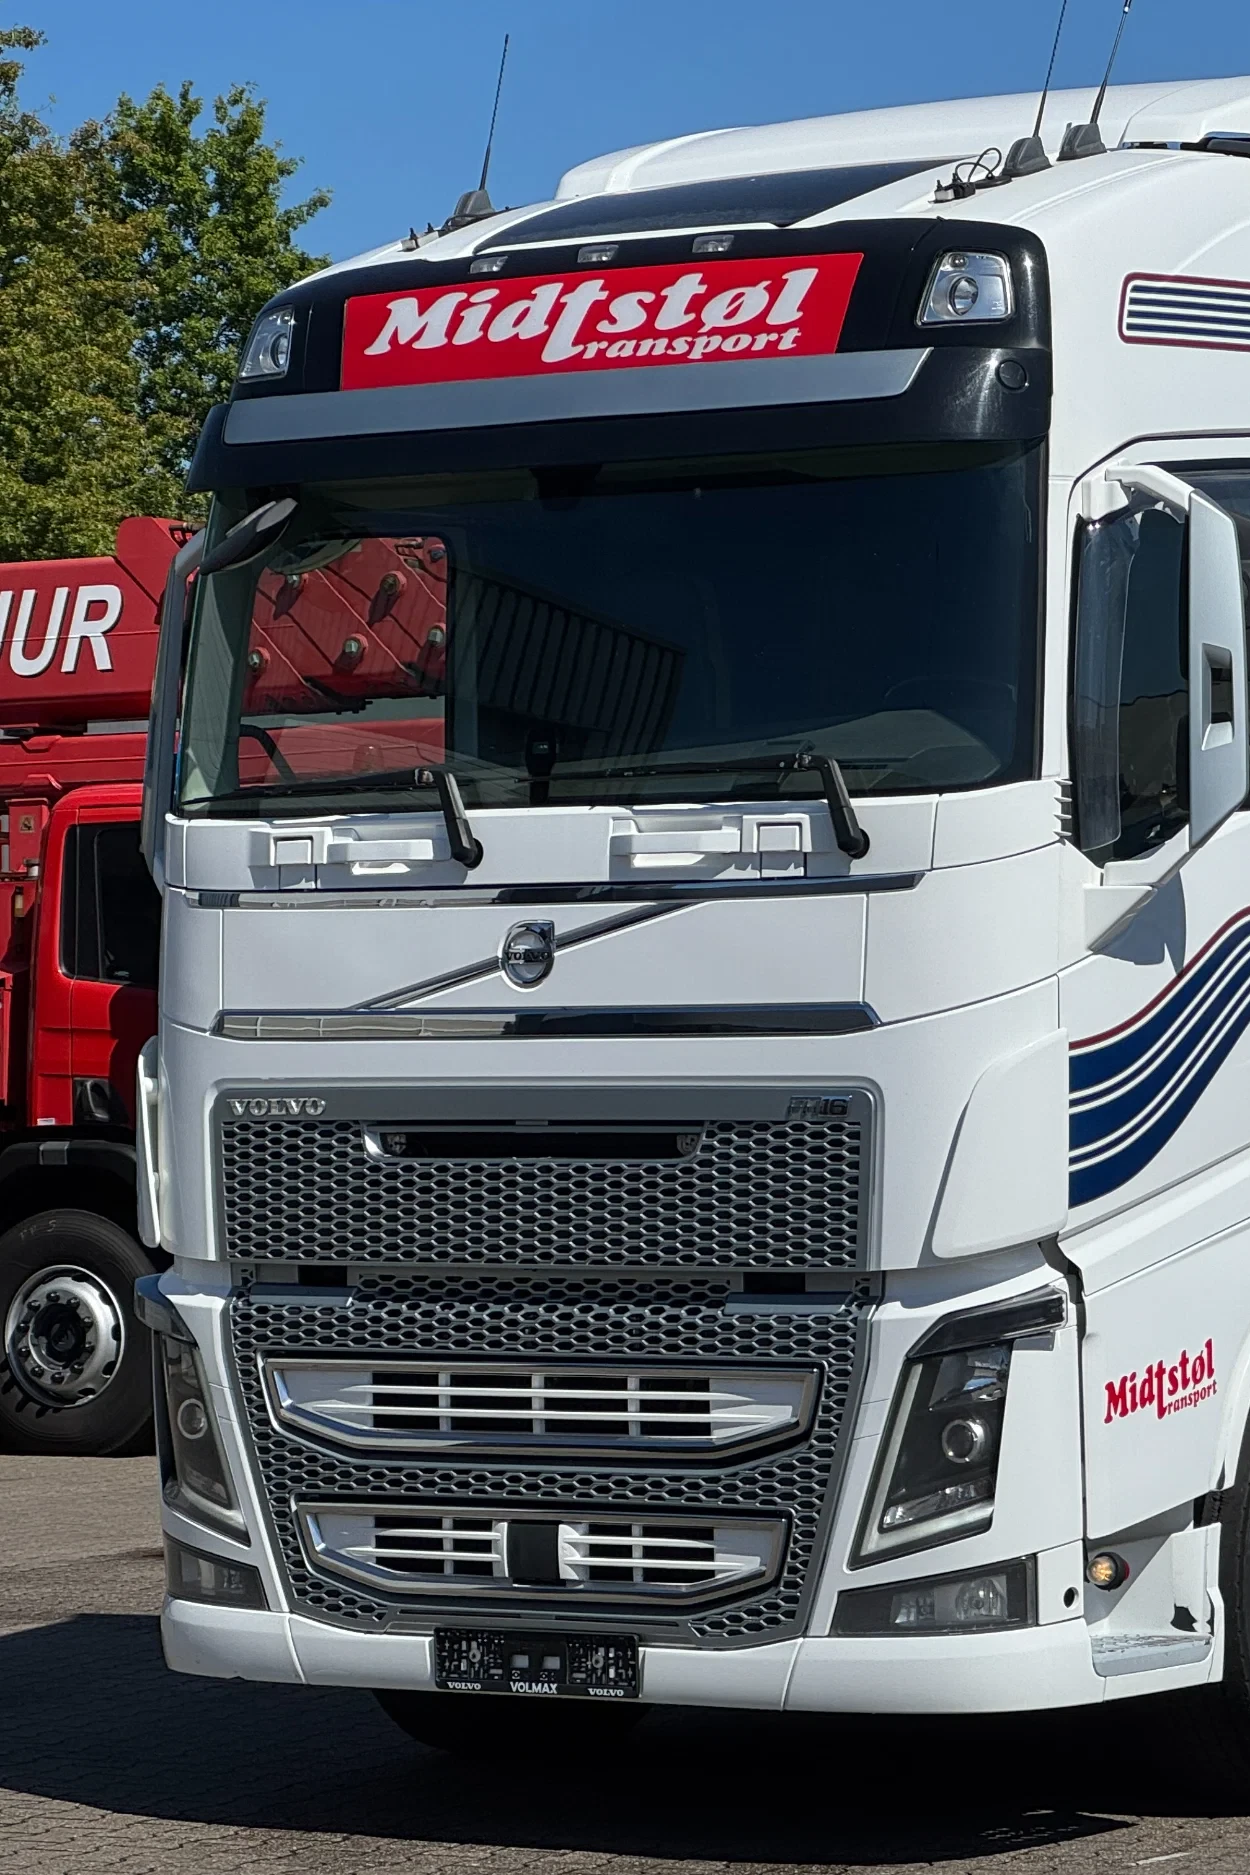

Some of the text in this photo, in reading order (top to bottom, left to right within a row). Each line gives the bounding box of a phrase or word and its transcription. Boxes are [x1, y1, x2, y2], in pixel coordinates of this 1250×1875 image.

[364, 268, 819, 363] Midtstøl
[0, 584, 123, 677] UR
[226, 1097, 327, 1116] VOLVO
[1104, 1338, 1214, 1424] Midtstøl
[447, 1681, 482, 1690] VOLVO
[510, 1681, 558, 1695] VOLMAX
[587, 1687, 625, 1697] VOLVO
